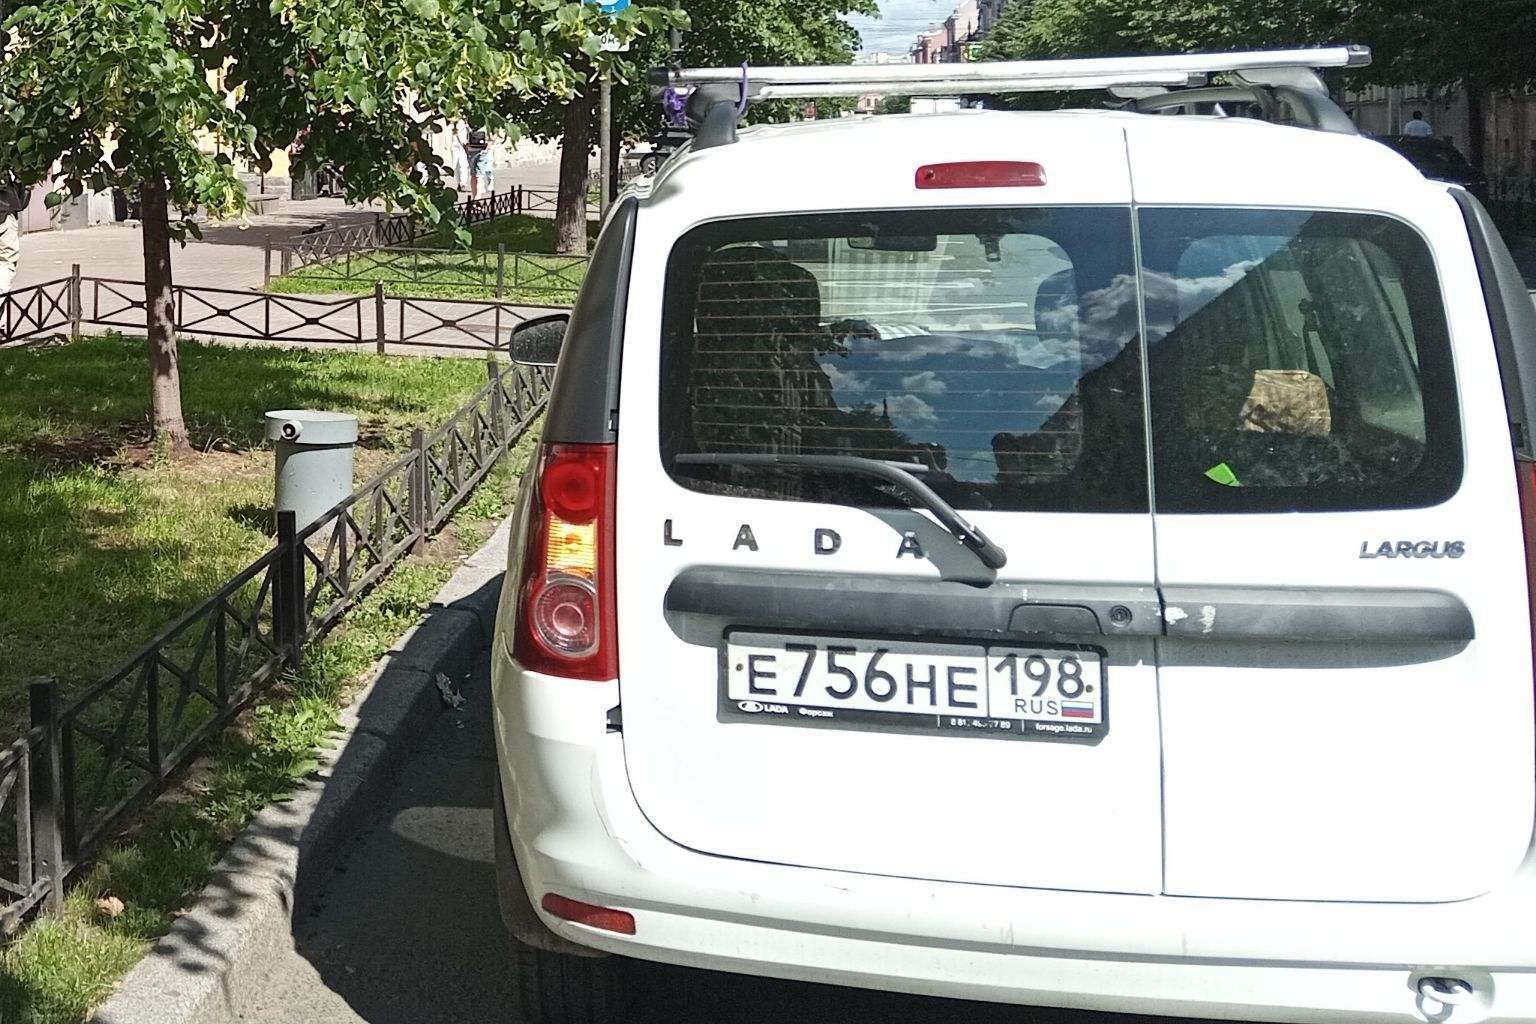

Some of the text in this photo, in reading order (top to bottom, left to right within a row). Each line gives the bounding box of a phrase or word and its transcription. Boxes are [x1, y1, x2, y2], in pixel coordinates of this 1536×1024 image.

[664, 519, 924, 559] LADA
[1359, 540, 1465, 559] LARGUS
[749, 643, 1084, 709] Е756НЕ 198
[764, 704, 789, 714] LADA
[798, 707, 834, 717] Форсаж
[1015, 698, 1058, 716] RUS
